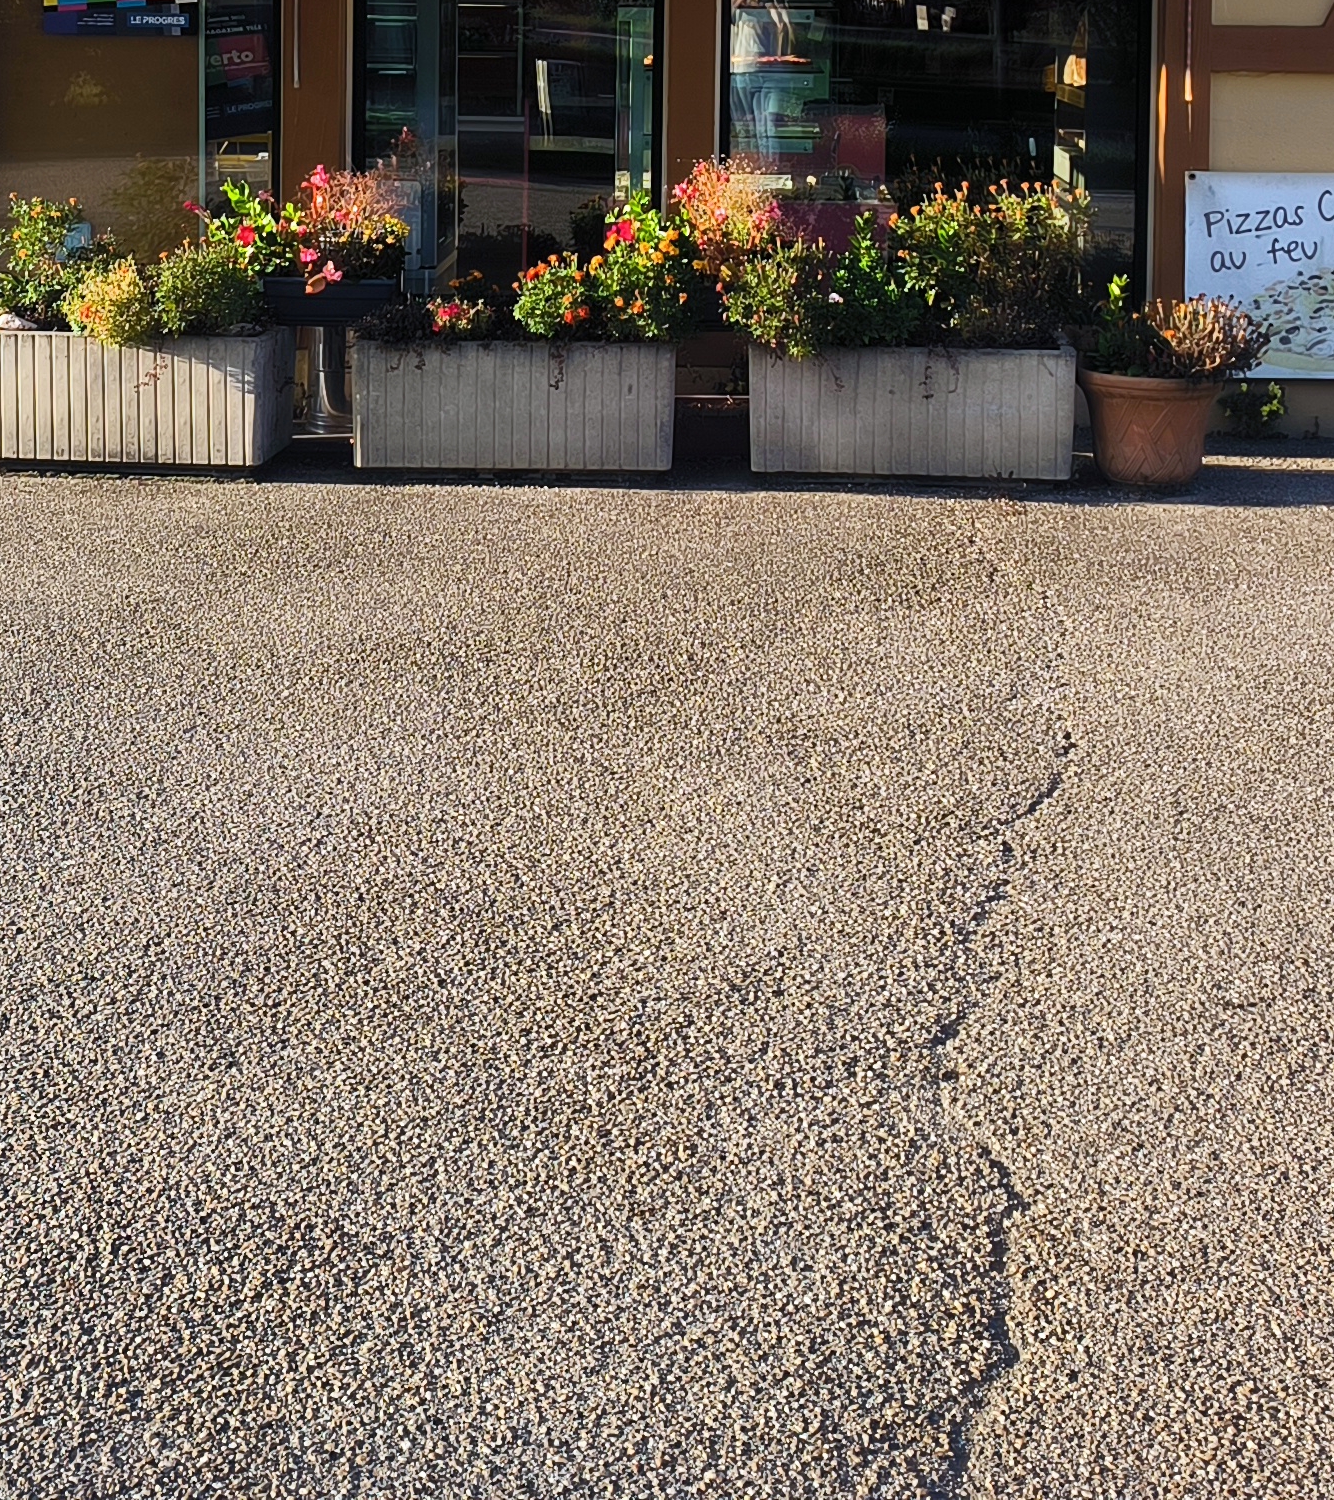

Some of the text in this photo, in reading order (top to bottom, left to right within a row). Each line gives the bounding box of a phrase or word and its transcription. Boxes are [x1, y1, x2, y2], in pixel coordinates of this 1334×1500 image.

[130, 16, 142, 24] LE
[1203, 203, 1304, 238] Pizzas
[1209, 247, 1247, 273] au
[1267, 238, 1319, 266] feu
